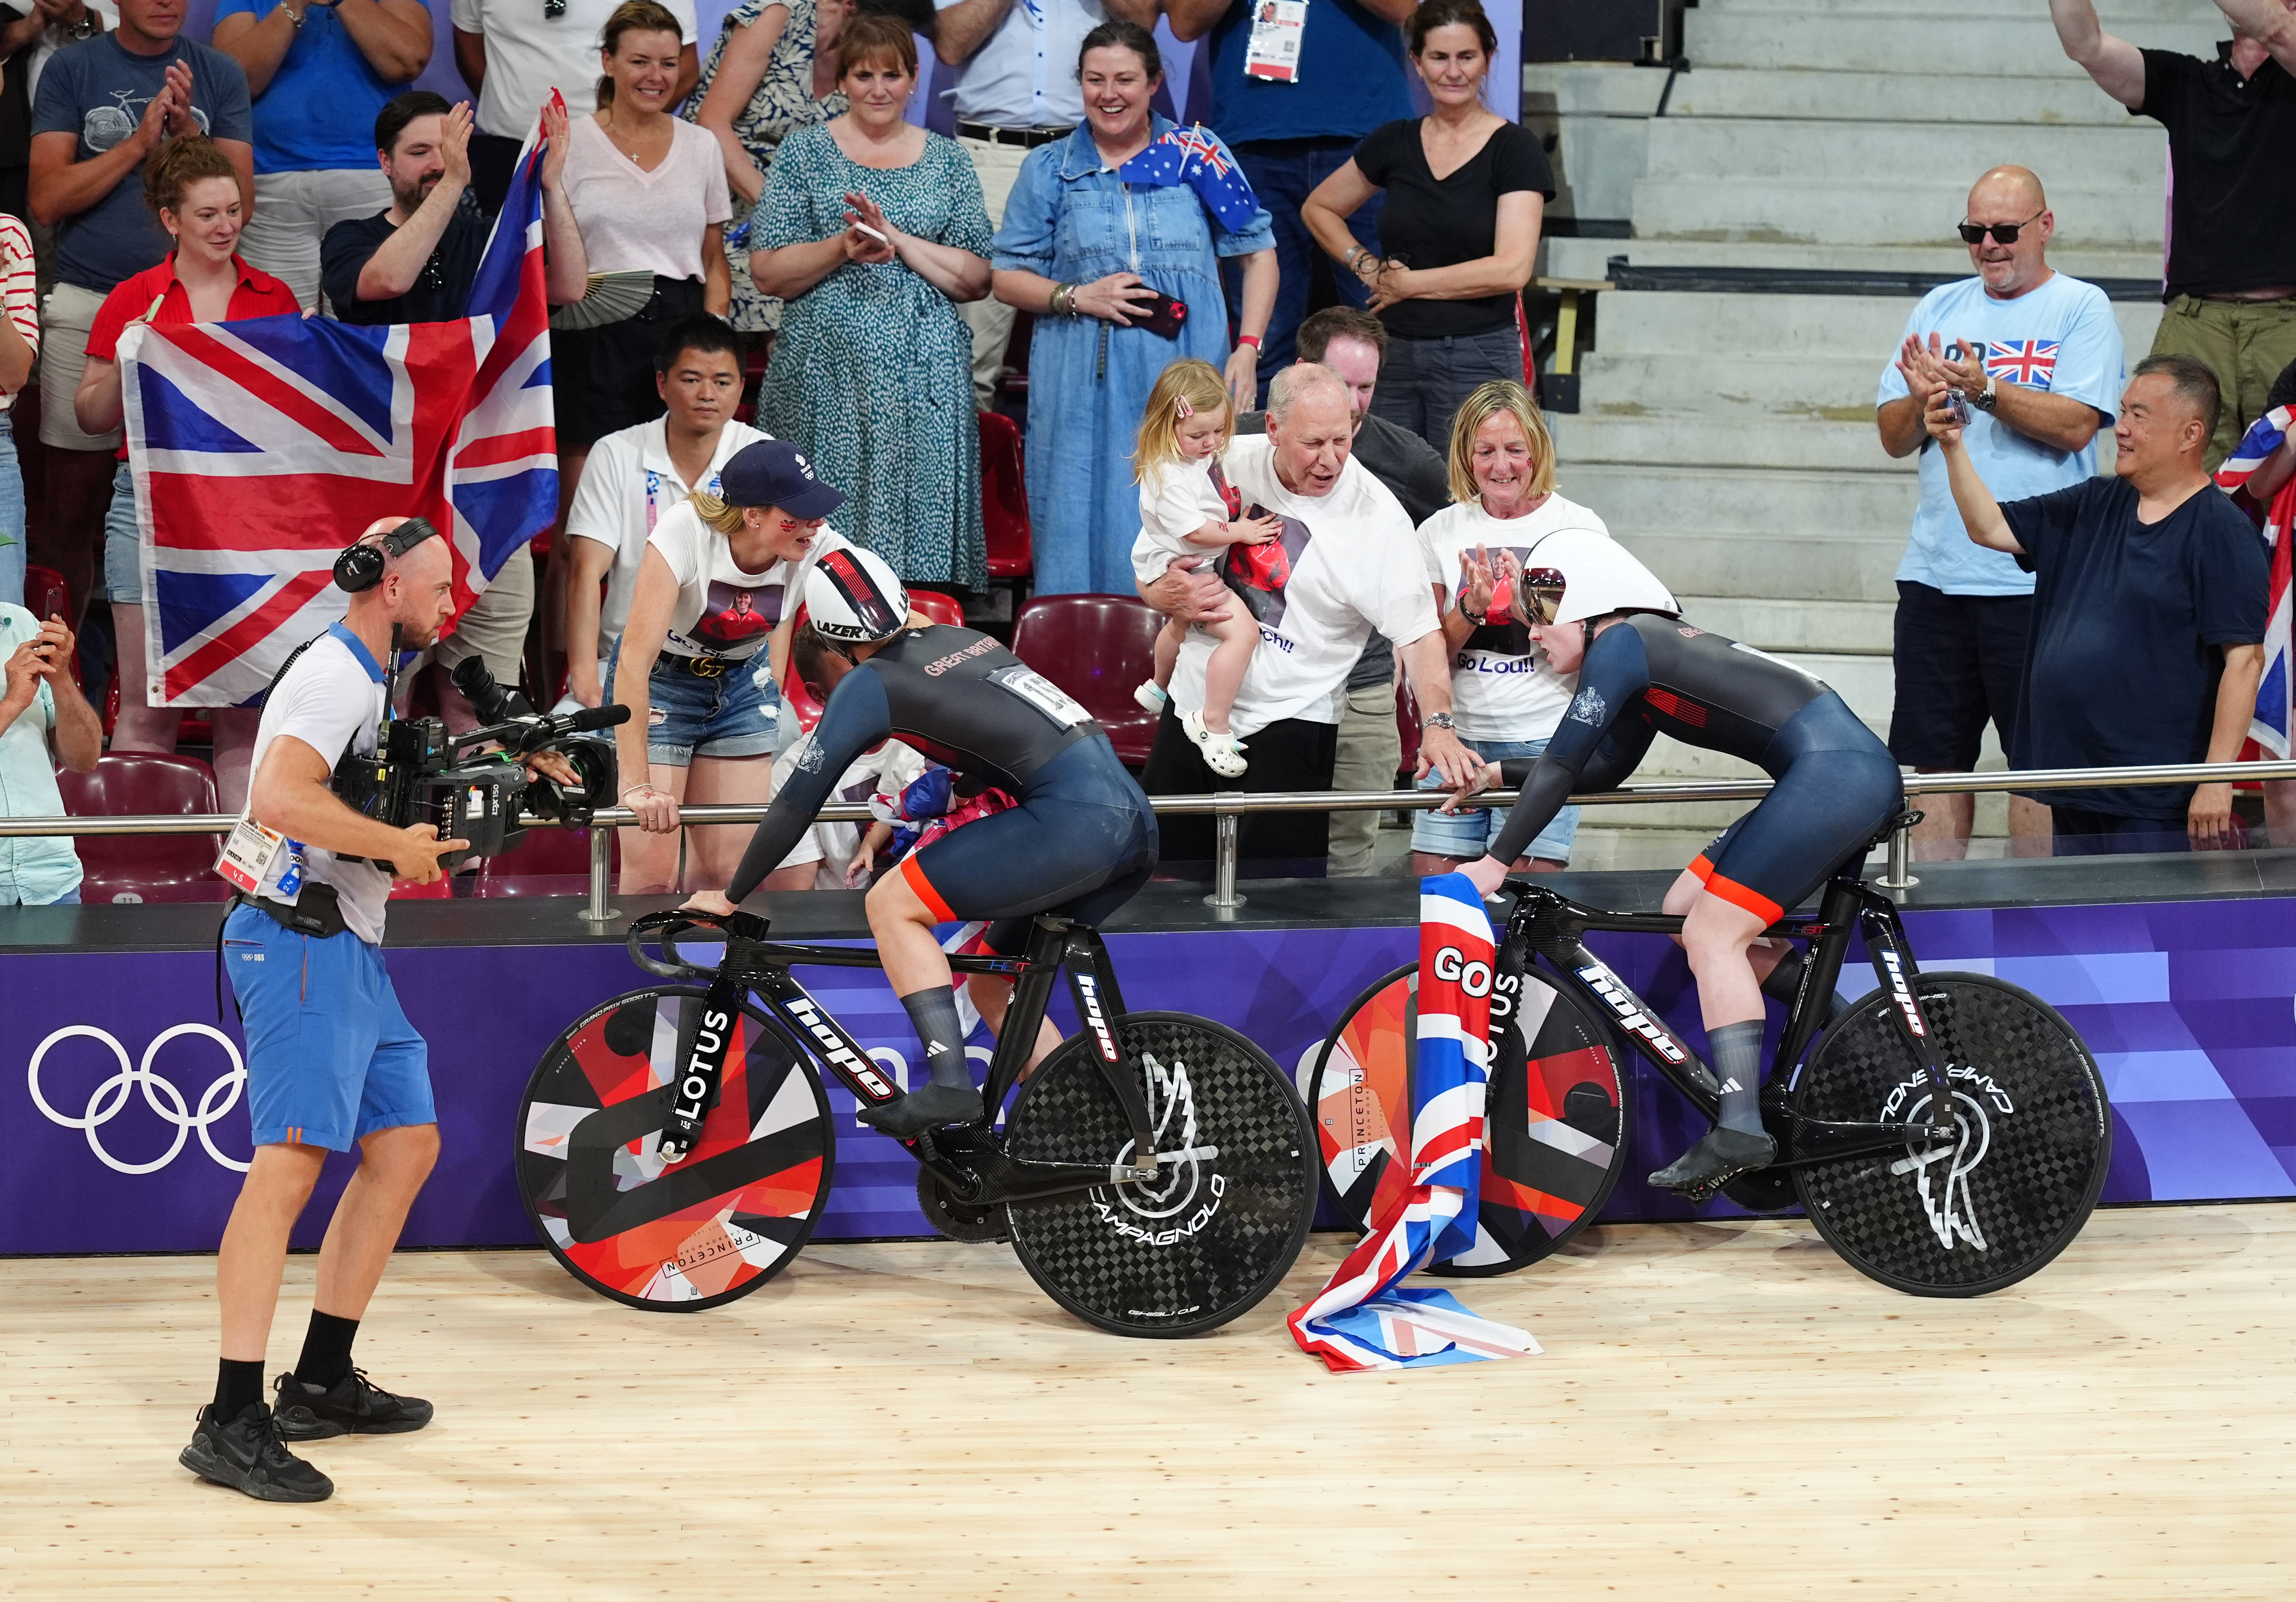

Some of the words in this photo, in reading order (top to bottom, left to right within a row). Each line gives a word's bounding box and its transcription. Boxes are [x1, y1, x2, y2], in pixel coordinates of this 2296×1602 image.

[817, 620, 864, 638] LAZER
[1259, 628, 1294, 654] ch!!
[924, 651, 971, 677] GREAT
[1479, 656, 1535, 674] Lou!!
[254, 953, 265, 961] OBS
[1434, 946, 1492, 999] GO
[1882, 951, 1925, 1035] hope
[580, 1008, 603, 1029] GRAND
[603, 1001, 621, 1014] PRIX
[621, 994, 644, 1005] 5000
[1077, 974, 1117, 1060] hope
[1578, 965, 1686, 1062] hope
[786, 997, 891, 1097] hope
[1575, 1025, 1590, 1044] round
[556, 1054, 571, 1075] round
[675, 1009, 728, 1120] LOTUS
[1355, 1074, 1366, 1166] PRINCETON
[667, 1233, 753, 1272] PRINCETON
[1129, 1309, 1175, 1317] GHIBLI
[1177, 1305, 1200, 1315] 0.9
